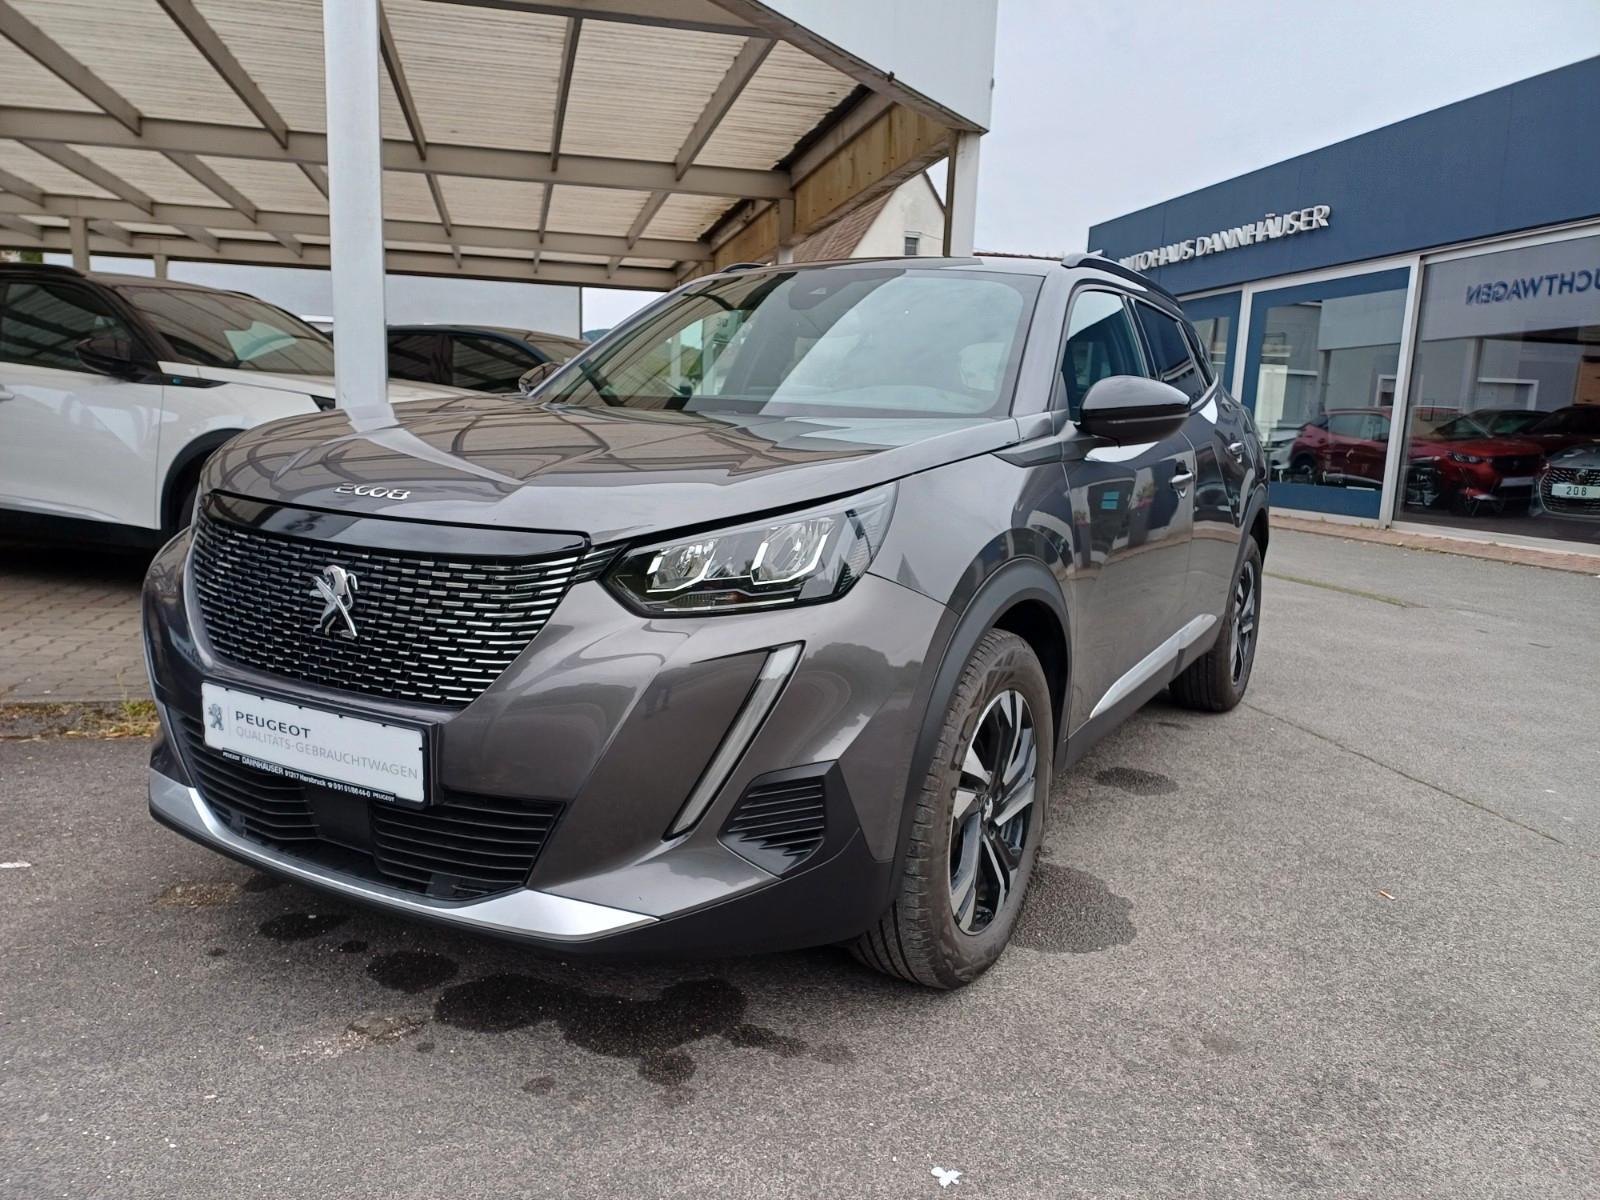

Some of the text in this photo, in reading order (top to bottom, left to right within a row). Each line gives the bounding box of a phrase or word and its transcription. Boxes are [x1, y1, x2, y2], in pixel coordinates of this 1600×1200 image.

[1195, 204, 1331, 256] DANNHÄUSER
[334, 482, 411, 500] 2008
[1566, 486, 1587, 497] 208
[235, 710, 312, 739] PEUGEOT
